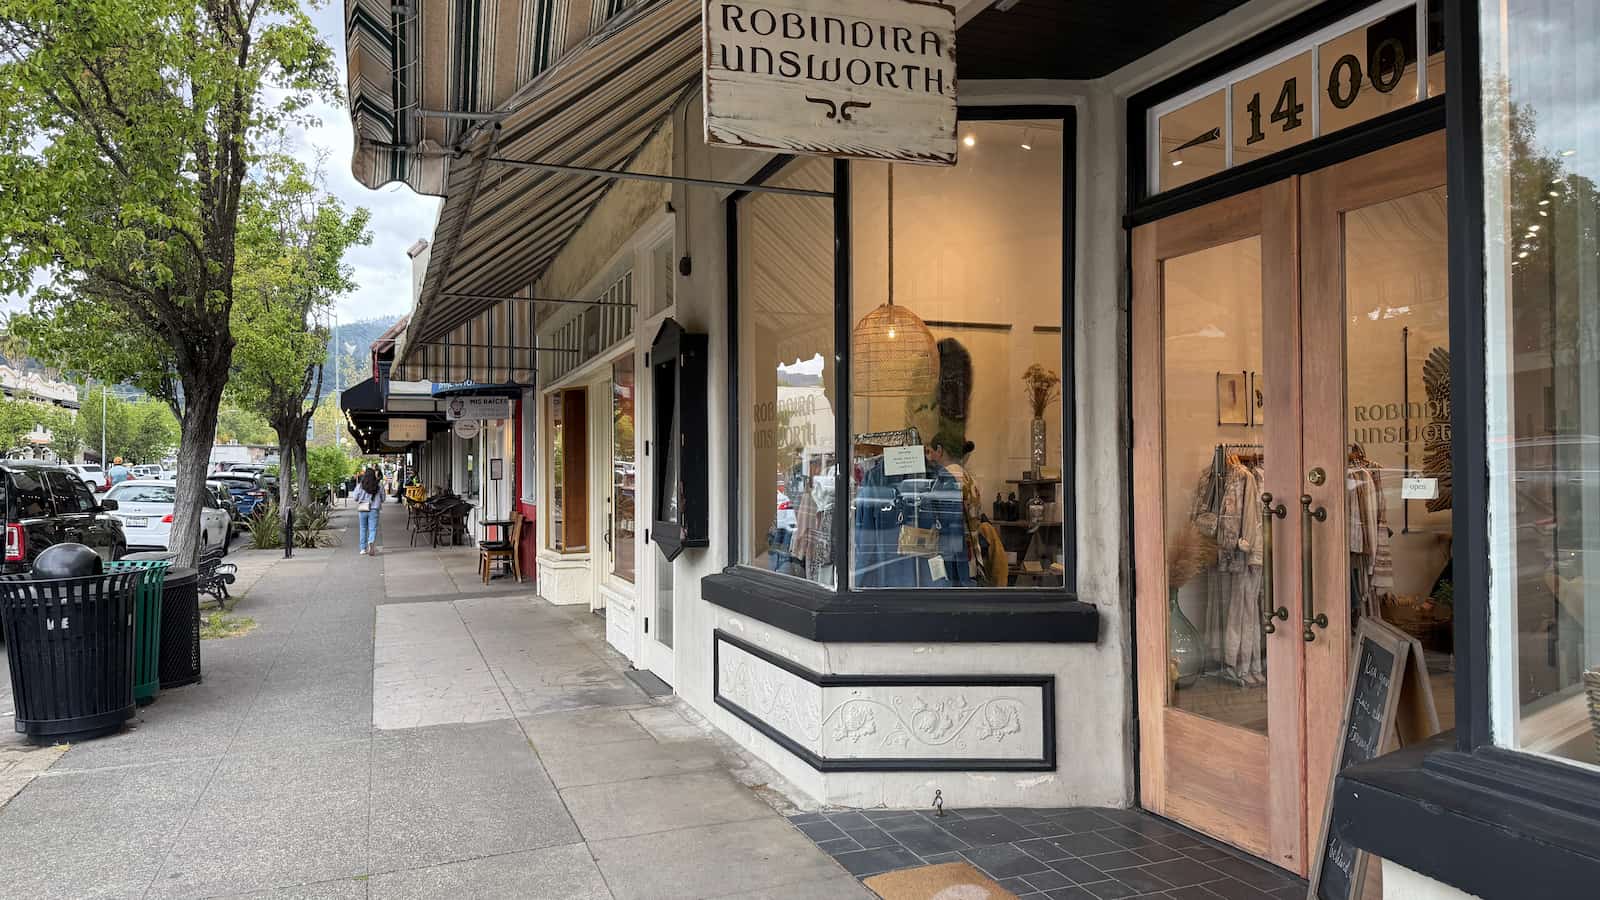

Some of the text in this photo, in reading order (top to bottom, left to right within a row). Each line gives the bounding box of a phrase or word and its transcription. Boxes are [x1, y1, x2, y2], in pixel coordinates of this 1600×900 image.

[721, 4, 942, 57] ROBINDIRA
[720, 44, 944, 94] UNSWORTH
[1246, 38, 1406, 146] 1400
